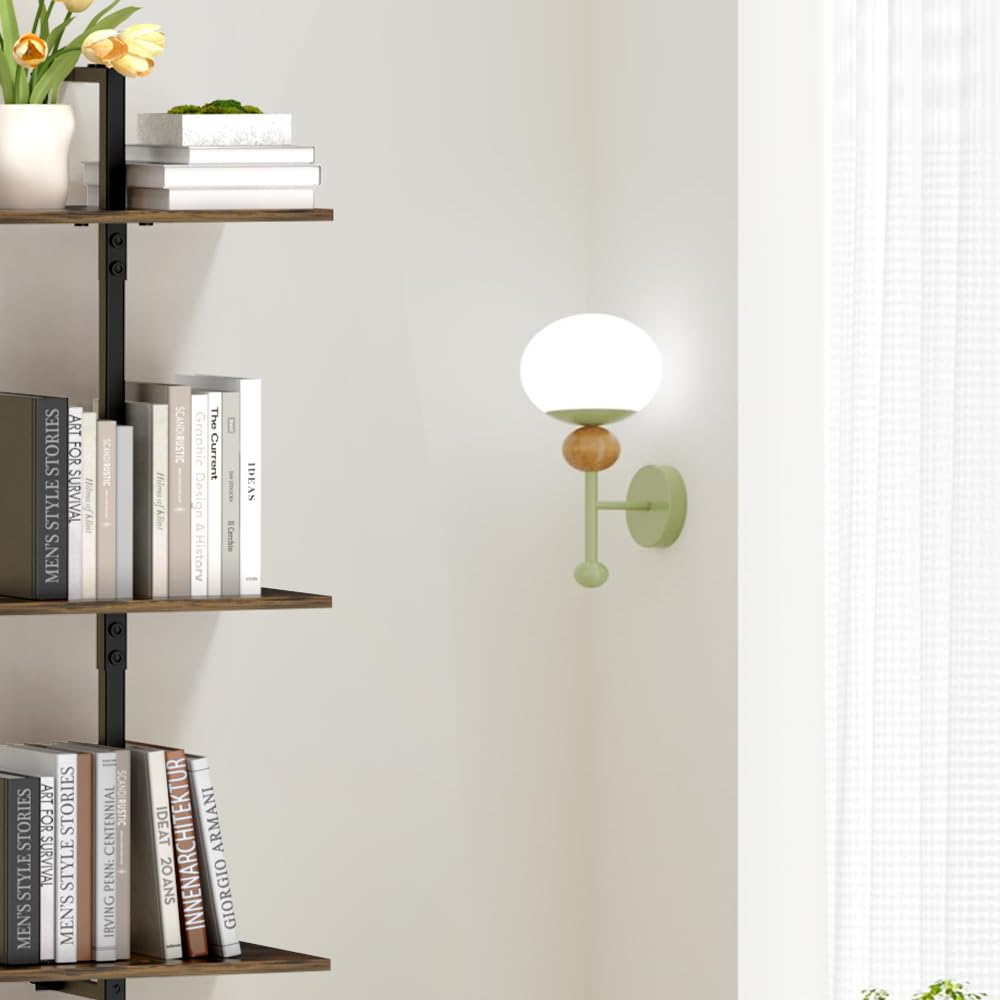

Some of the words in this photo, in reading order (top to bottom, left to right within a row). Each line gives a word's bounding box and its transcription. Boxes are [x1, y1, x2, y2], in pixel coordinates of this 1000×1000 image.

[45, 408, 60, 476] STORIES
[68, 415, 82, 437] ART
[210, 407, 219, 430] The
[68, 441, 82, 465] FOR
[210, 433, 219, 480] Current
[45, 480, 60, 530] STYLE
[68, 469, 82, 524] SURVIVAL
[191, 473, 206, 518] Design
[247, 463, 256, 502] IDEAS
[45, 534, 60, 584] MEN'S
[40, 784, 53, 805] ART
[60, 766, 75, 835] STORIES
[17, 788, 32, 851] STORIES
[40, 809, 53, 832] FOR
[104, 787, 115, 856] CENTENNIAL
[167, 757, 206, 931] INNENARCHITEKTUR
[202, 786, 225, 853] ARMANI
[17, 854, 32, 902] STYLE
[40, 836, 53, 887] SURVIVAL
[60, 839, 75, 891] STYLE
[104, 860, 115, 892] PENN:
[163, 878, 175, 905] ANS
[214, 858, 237, 930] GIORGIO
[17, 904, 32, 950] MEN'S
[60, 894, 75, 946] MEN'S
[104, 896, 115, 938] IRVING
